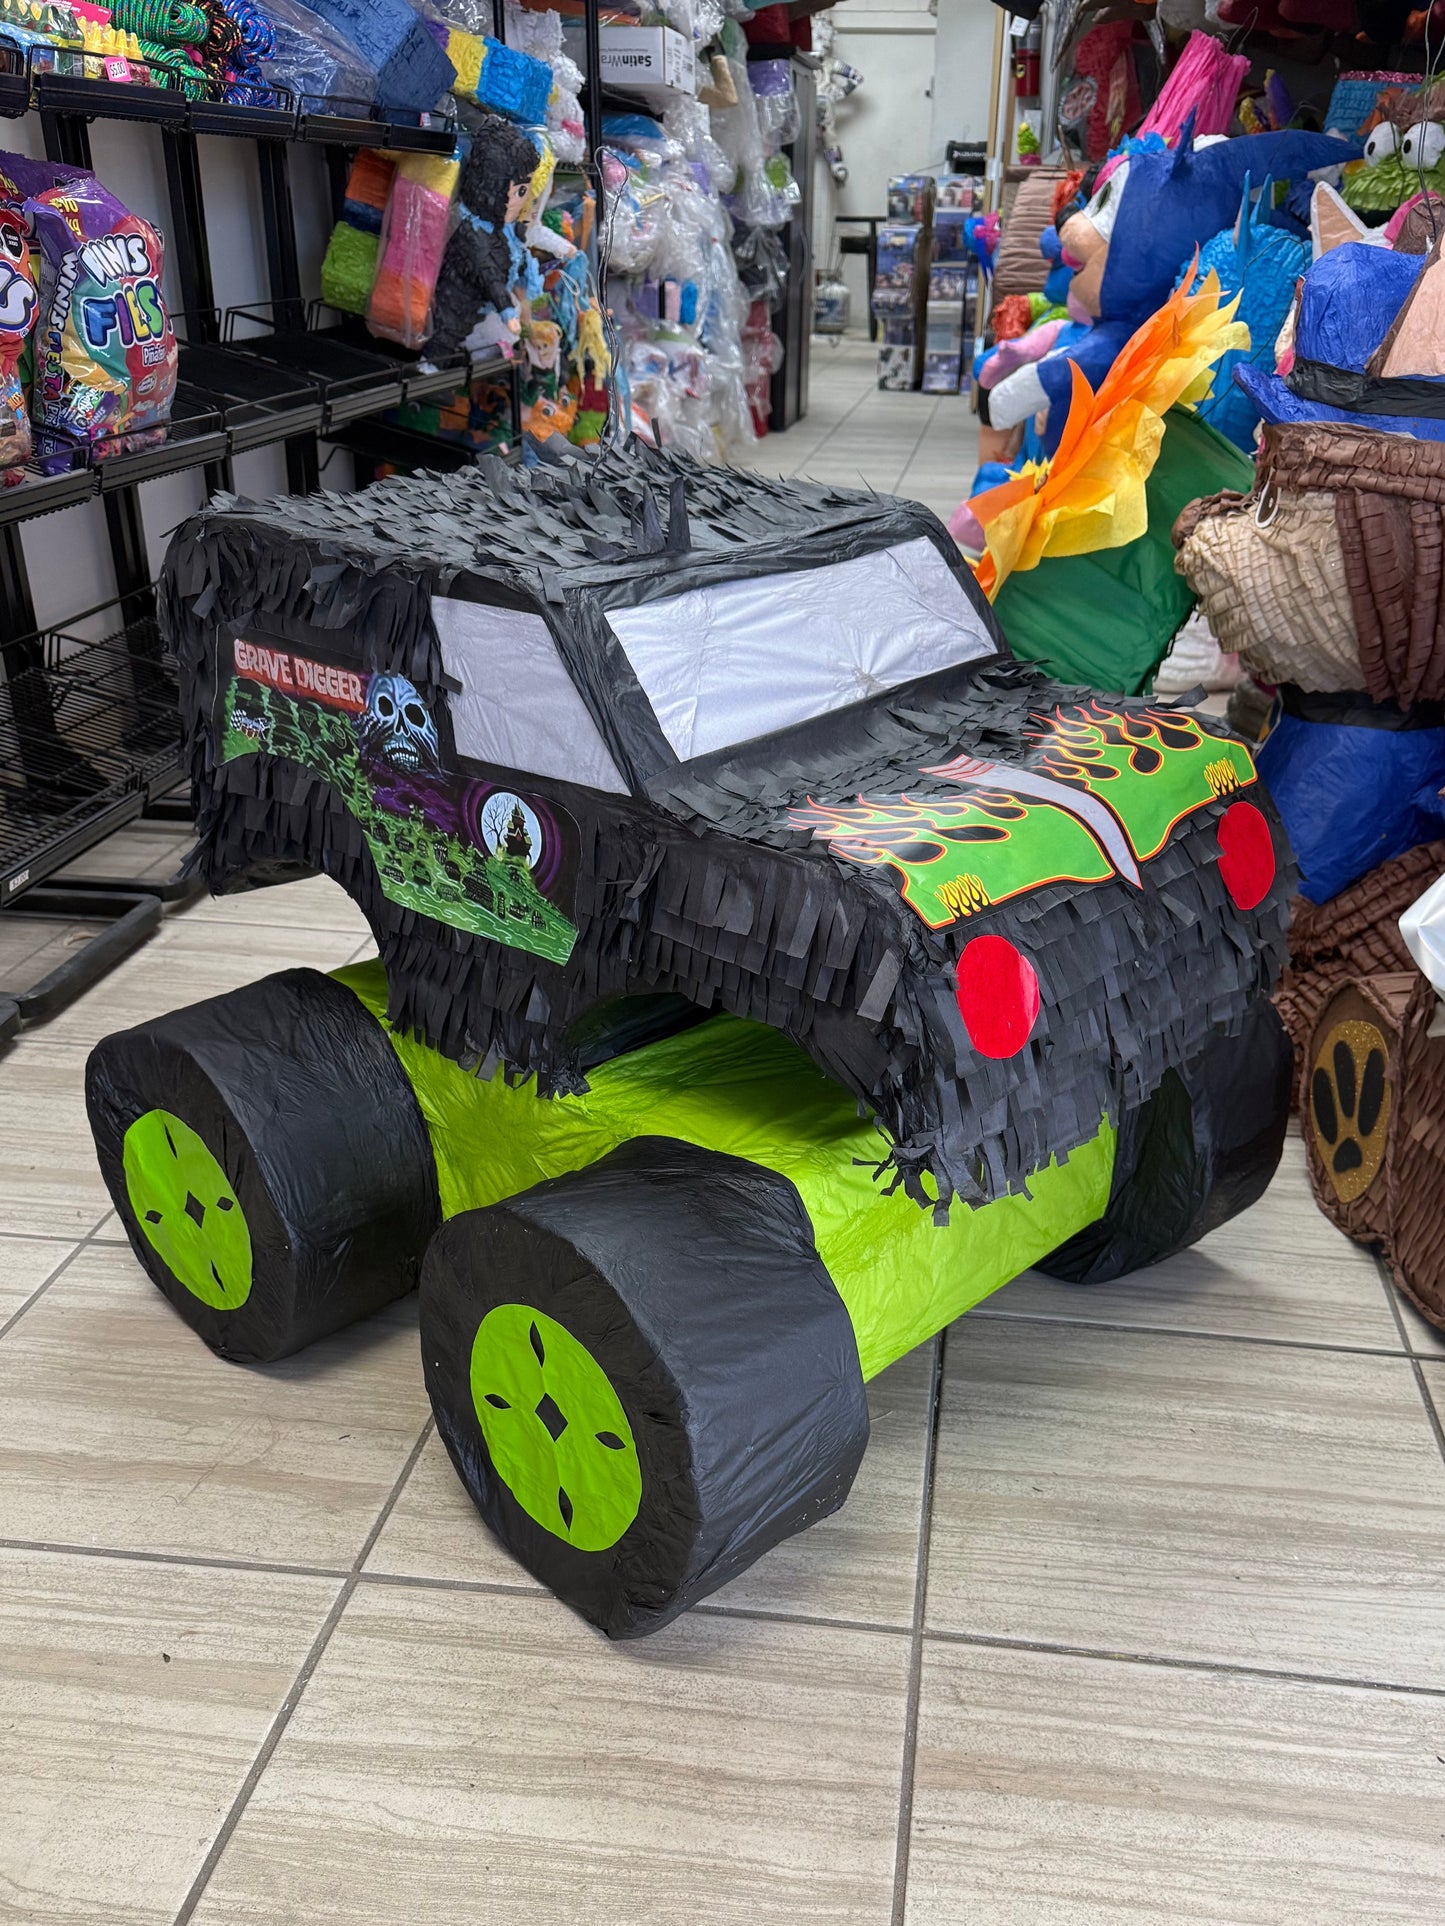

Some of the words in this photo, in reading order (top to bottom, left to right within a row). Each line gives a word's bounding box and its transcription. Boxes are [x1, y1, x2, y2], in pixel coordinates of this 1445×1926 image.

[109, 61, 126, 77] $5.00
[600, 54, 652, 67] SatinWra
[50, 250, 80, 333] WINIS
[82, 279, 170, 349] FIES
[42, 330, 64, 401] FIESTA
[233, 638, 294, 686] GRAVE
[294, 657, 365, 705] DIGGER
